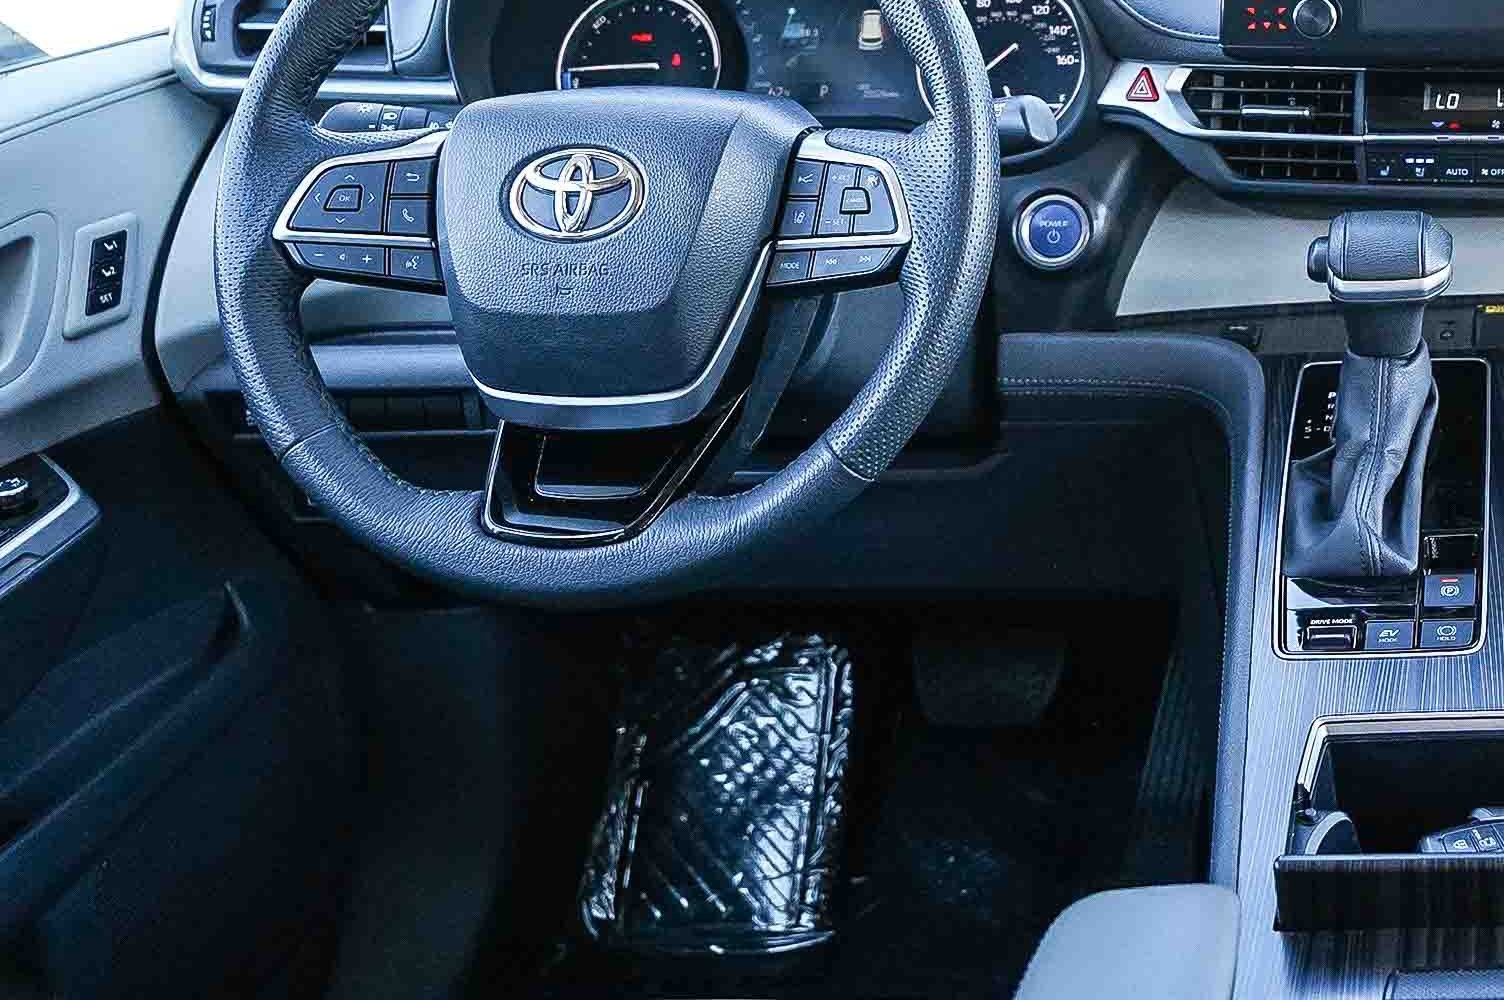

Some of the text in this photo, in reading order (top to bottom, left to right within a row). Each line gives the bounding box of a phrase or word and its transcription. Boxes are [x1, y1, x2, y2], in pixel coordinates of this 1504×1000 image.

[1032, 5, 1050, 15] 120
[1048, 25, 1068, 36] 140
[1056, 54, 1075, 66] 160
[1435, 93, 1460, 110] LO
[1445, 168, 1469, 176] AUTO
[1490, 168, 1504, 176] OFF
[338, 194, 351, 203] OK
[521, 262, 610, 277] SRS AIRBAG
[780, 261, 800, 270] MODE
[1327, 391, 1337, 399] P
[1378, 628, 1399, 638] EV
